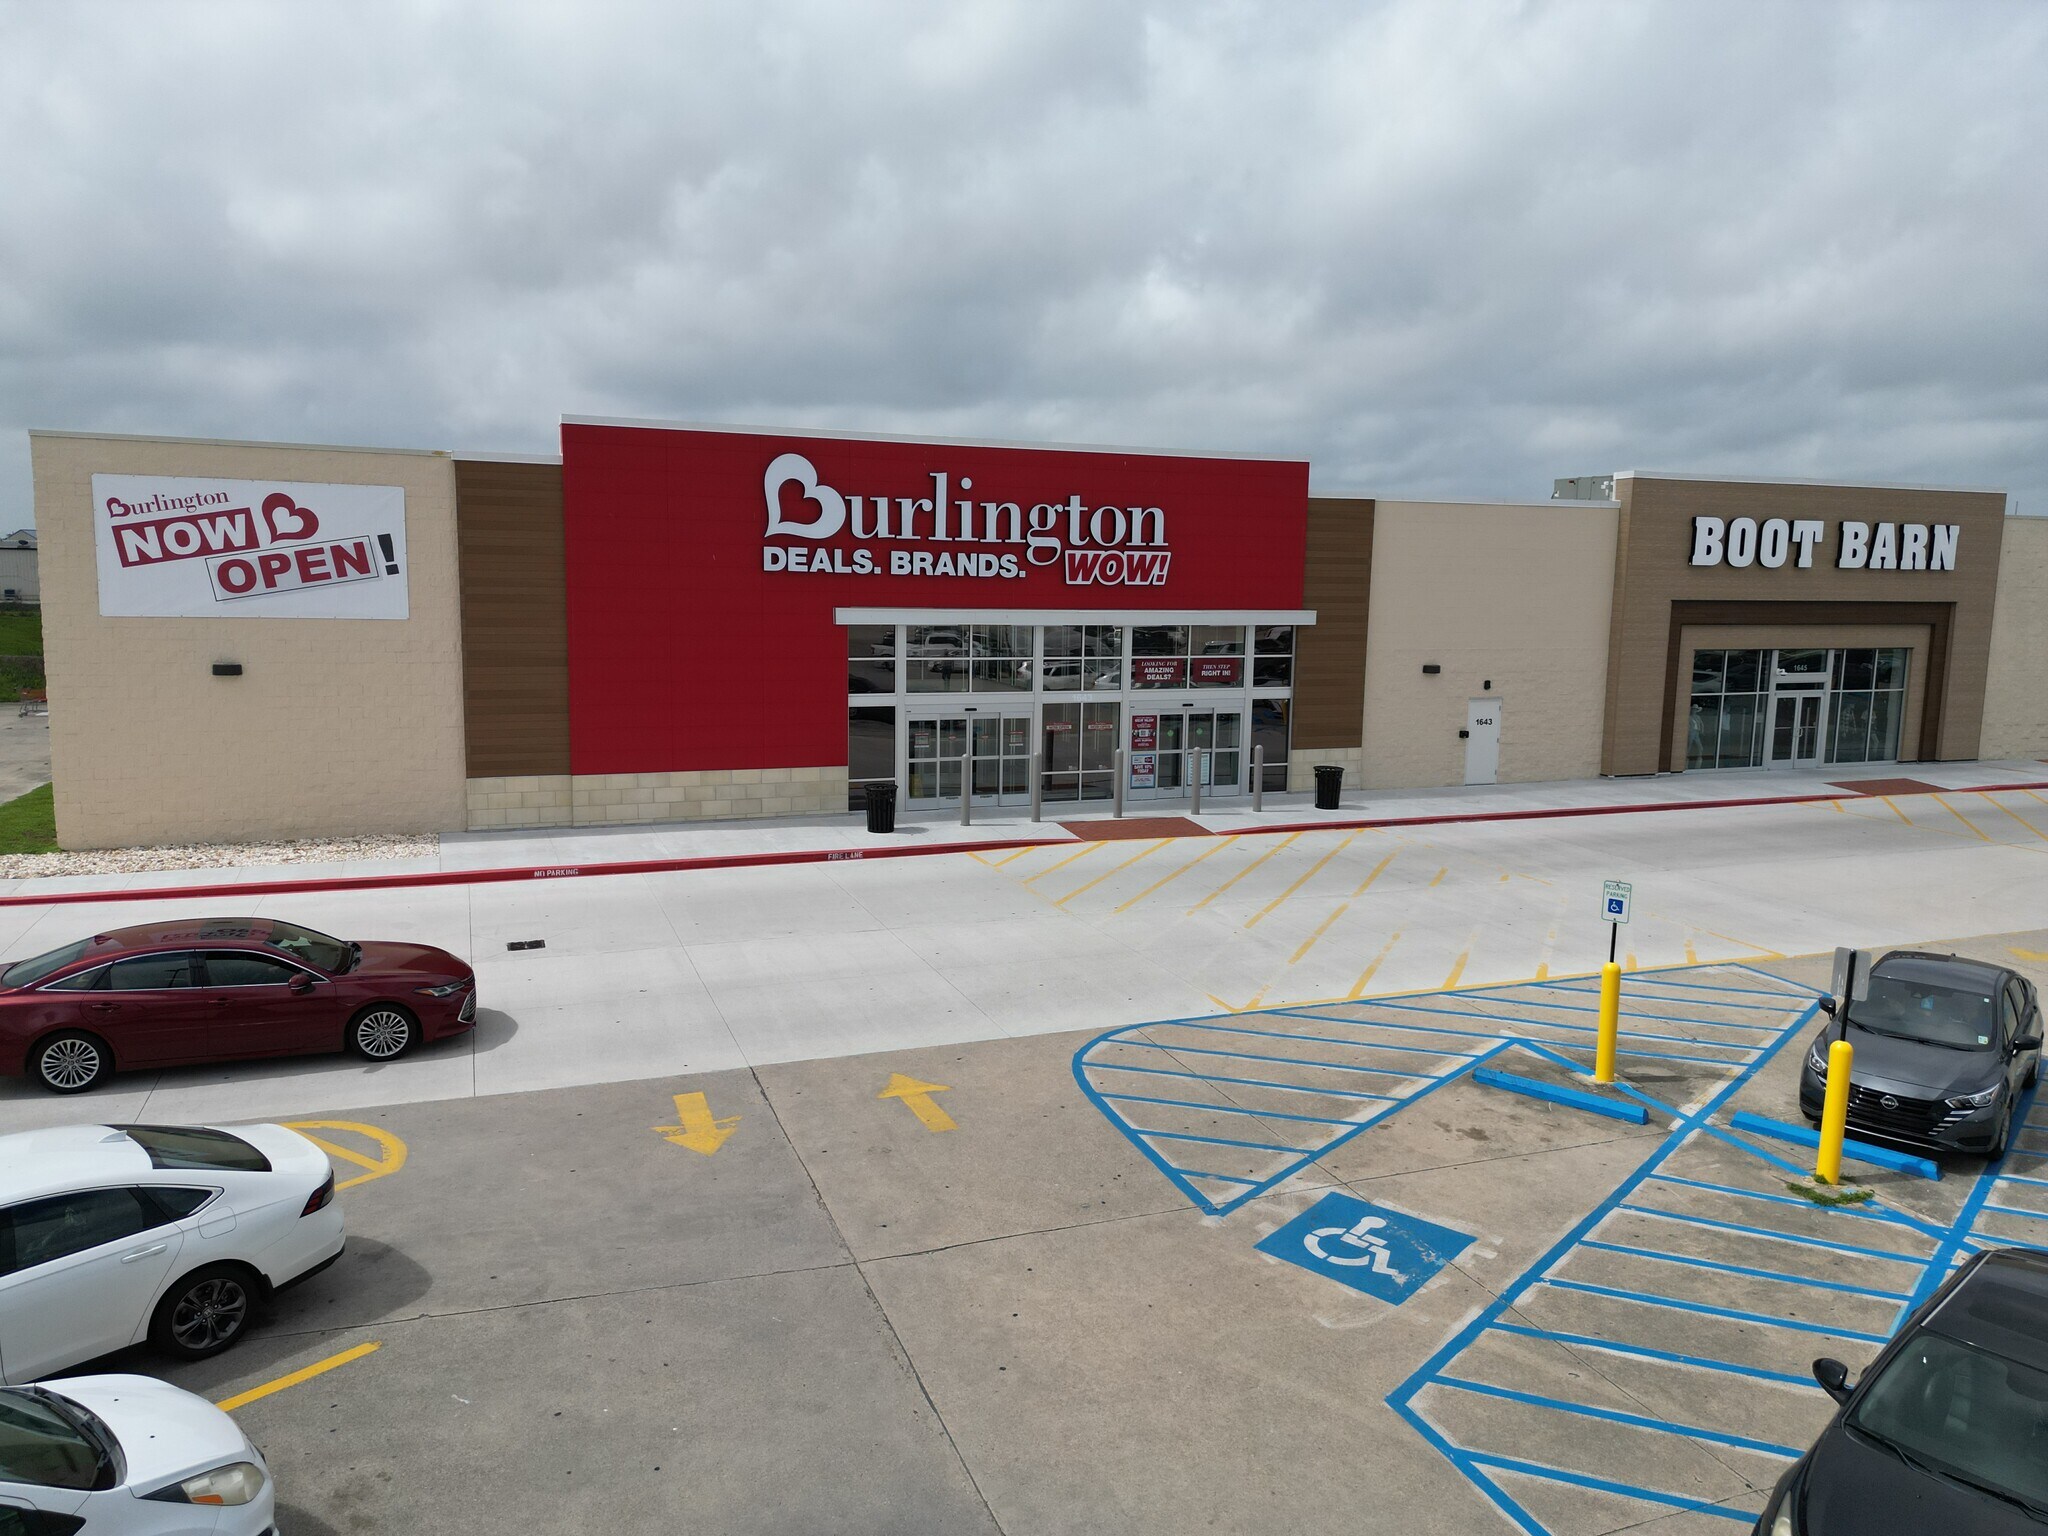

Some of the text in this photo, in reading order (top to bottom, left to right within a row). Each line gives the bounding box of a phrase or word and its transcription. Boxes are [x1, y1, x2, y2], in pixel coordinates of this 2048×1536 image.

[106, 490, 231, 518] Burlington
[764, 452, 1169, 566] Burlington
[120, 513, 247, 563] NOW
[1692, 516, 1960, 570] BOOT BARN
[763, 546, 1026, 578] DEALS. BRANDS.
[1065, 550, 1171, 585] WOW!
[1476, 718, 1493, 726] 1643
[827, 852, 844, 860] FIRE
[534, 868, 579, 878] NO PARKING
